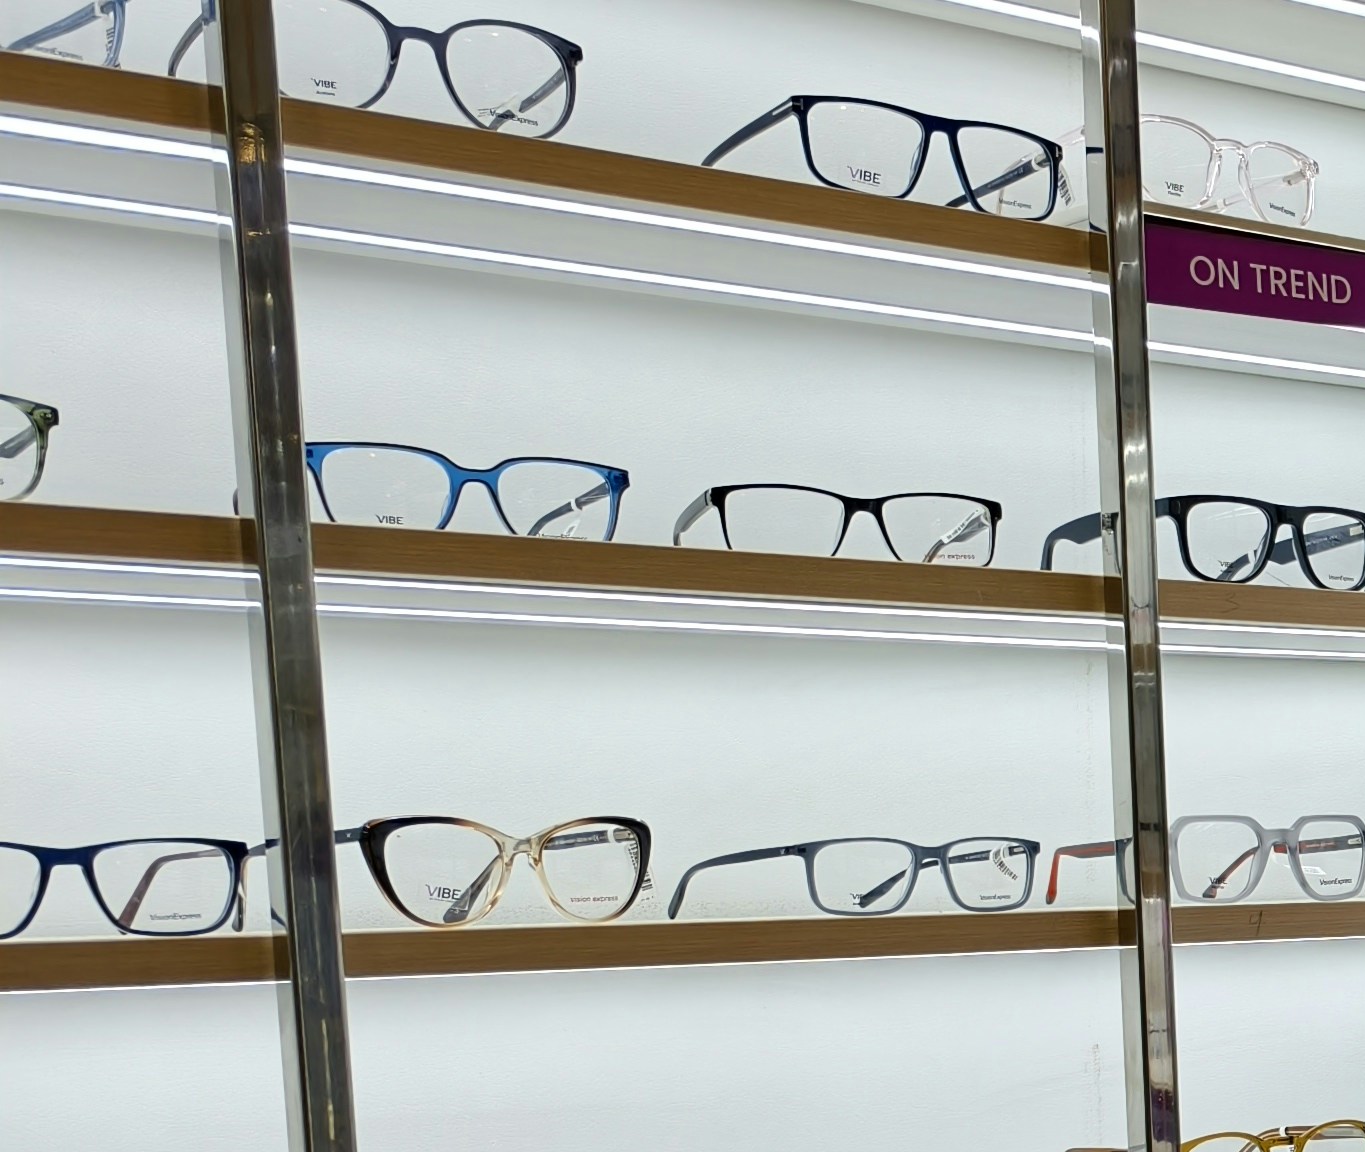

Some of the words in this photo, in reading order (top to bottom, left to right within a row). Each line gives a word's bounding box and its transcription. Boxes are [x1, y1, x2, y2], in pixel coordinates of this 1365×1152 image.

[311, 78, 337, 90] VIBE
[847, 166, 881, 183] VIBE
[1165, 181, 1185, 192] VIBE
[1189, 255, 1240, 290] ON
[1249, 263, 1352, 304] TREND
[376, 514, 404, 525] VIBE
[947, 553, 976, 561] express
[425, 884, 462, 900] VIBE
